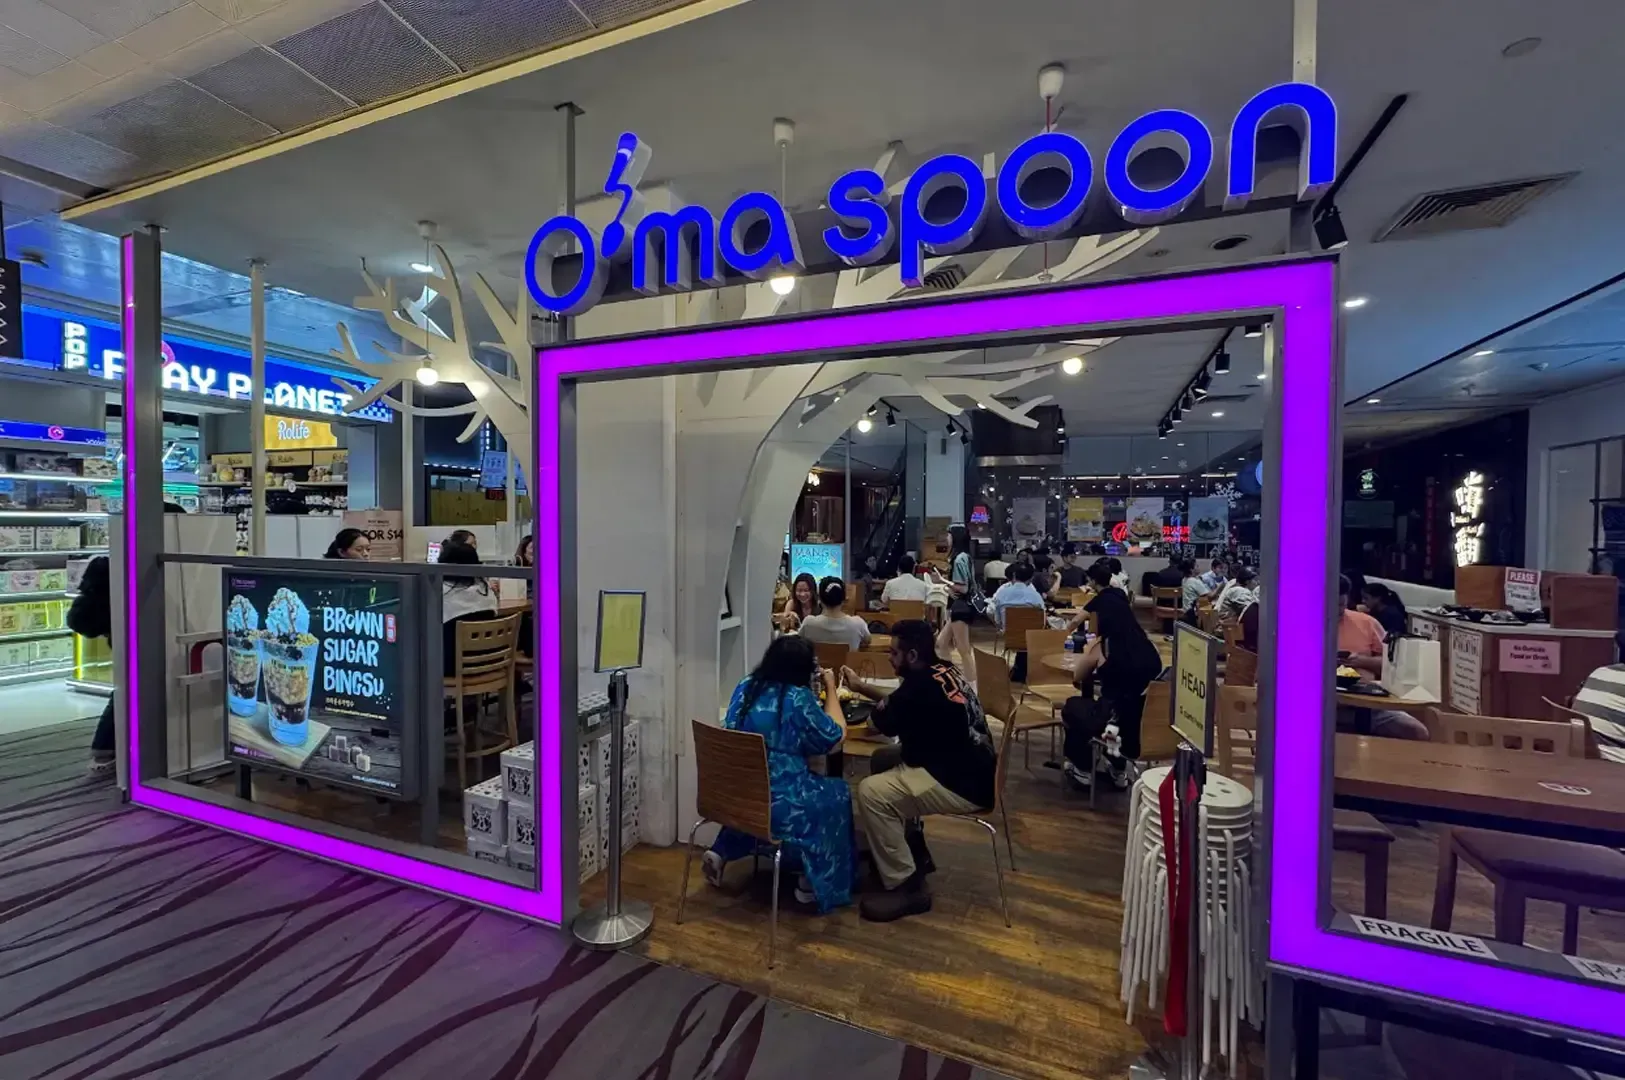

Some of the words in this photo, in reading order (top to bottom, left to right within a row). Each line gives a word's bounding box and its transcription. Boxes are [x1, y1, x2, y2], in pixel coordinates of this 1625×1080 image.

[822, 82, 1338, 284] spoon
[64, 321, 87, 369] POP
[103, 349, 217, 395] PAY
[278, 420, 310, 440] Rolife
[1510, 571, 1535, 583] PLEASE
[323, 638, 380, 667] SUGAR
[323, 666, 385, 698] BINGSU
[1181, 668, 1206, 699] HEAD
[1360, 919, 1486, 954] FRAGILE
